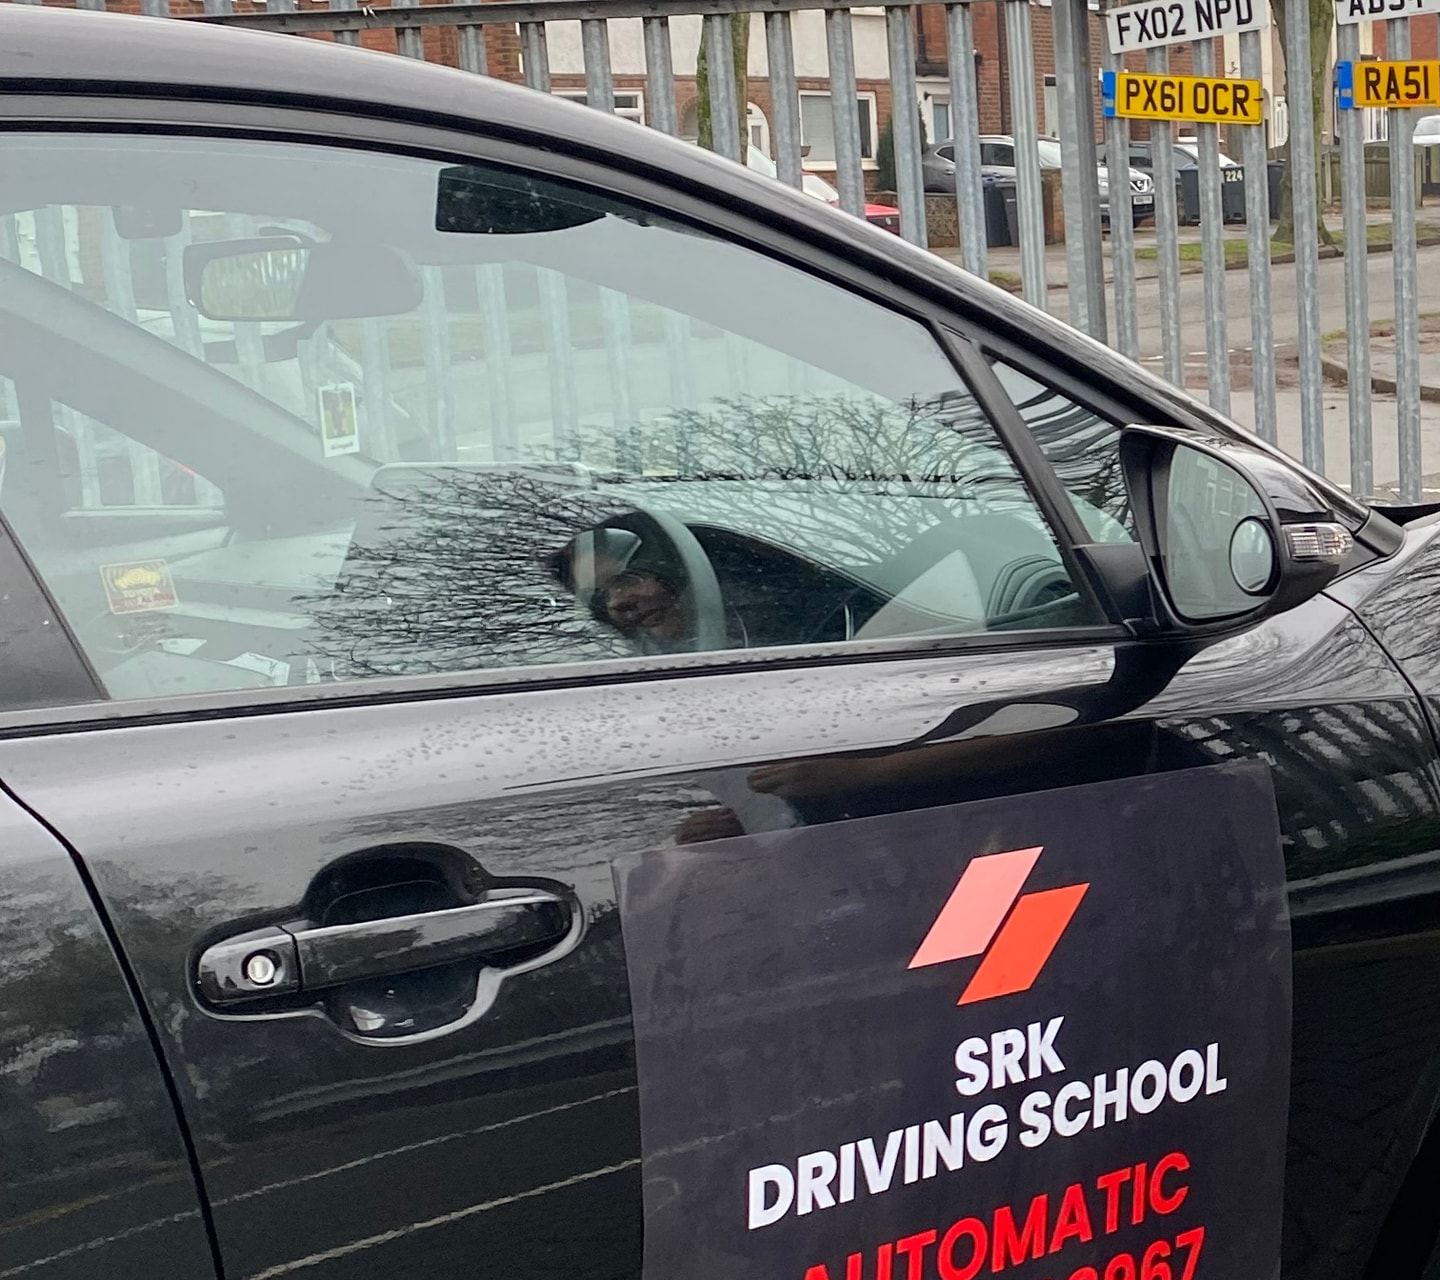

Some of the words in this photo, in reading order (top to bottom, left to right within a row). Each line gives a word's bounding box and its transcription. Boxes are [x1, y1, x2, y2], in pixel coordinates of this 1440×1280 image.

[1116, 3, 1186, 46] FX02
[1126, 78, 1184, 113] PX61
[1193, 82, 1250, 117] OCR
[1364, 65, 1430, 101] RA51
[1225, 170, 1243, 182] 224
[955, 1016, 1066, 1096] SRK
[748, 1104, 1009, 1230] DRIVING
[1019, 1042, 1227, 1148] SCHOOL
